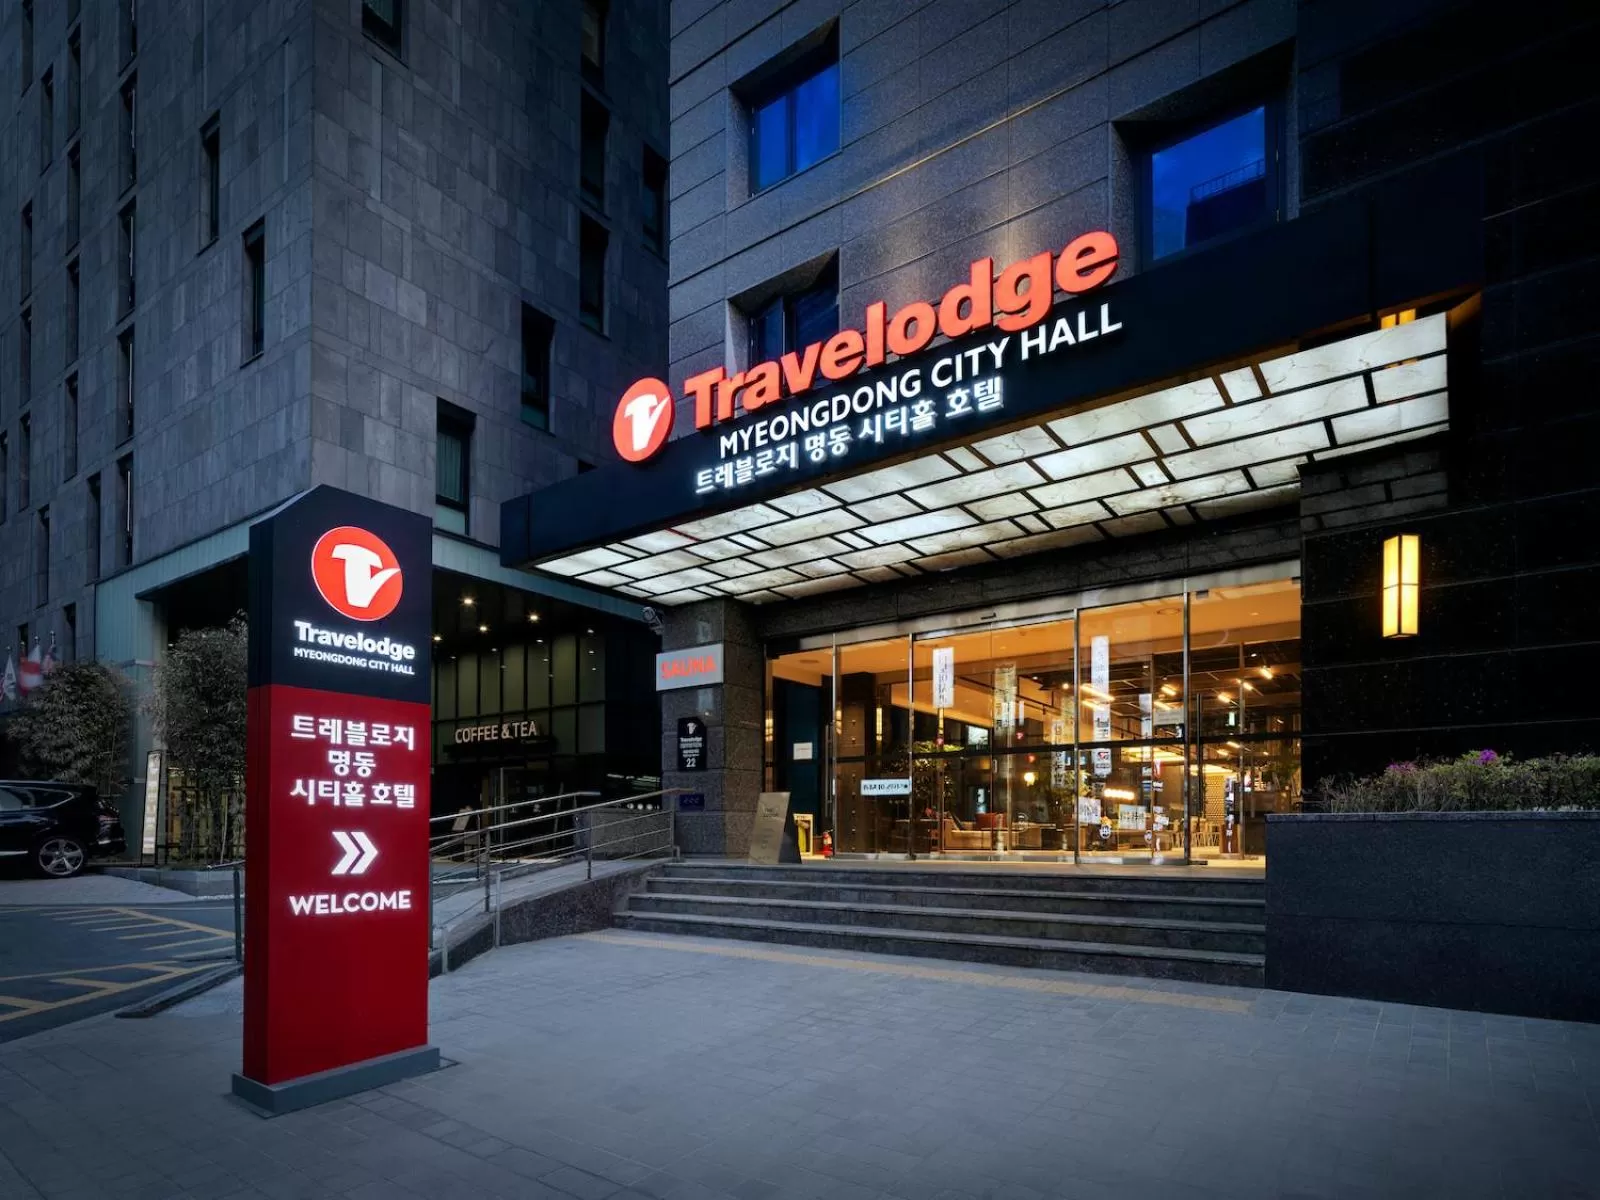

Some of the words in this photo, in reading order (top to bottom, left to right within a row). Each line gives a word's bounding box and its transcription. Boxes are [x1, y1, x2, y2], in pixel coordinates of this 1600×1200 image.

[684, 230, 1120, 430] Travelodge
[719, 368, 921, 459] MYEONGDONG
[931, 336, 1010, 388] CITY
[1021, 303, 1123, 361] HALL
[695, 441, 800, 495] 트레블로지
[804, 423, 853, 463] 명동
[858, 397, 937, 444] 시티홀
[944, 375, 1005, 419] 호텔
[293, 619, 416, 661] Travelodge
[293, 647, 368, 668] MYEONGDONG
[368, 659, 391, 671] CITY
[391, 664, 416, 676] HALL
[660, 655, 718, 680] SAUNA
[290, 714, 415, 751] 트레블로지
[455, 724, 499, 744] COFFEE
[501, 722, 514, 740] &
[512, 720, 538, 739] TEA
[327, 749, 377, 778] 명동
[686, 757, 697, 768] 22
[289, 779, 367, 807] 시티홀
[370, 782, 415, 809] 호텔
[288, 889, 412, 916] WELCOME
